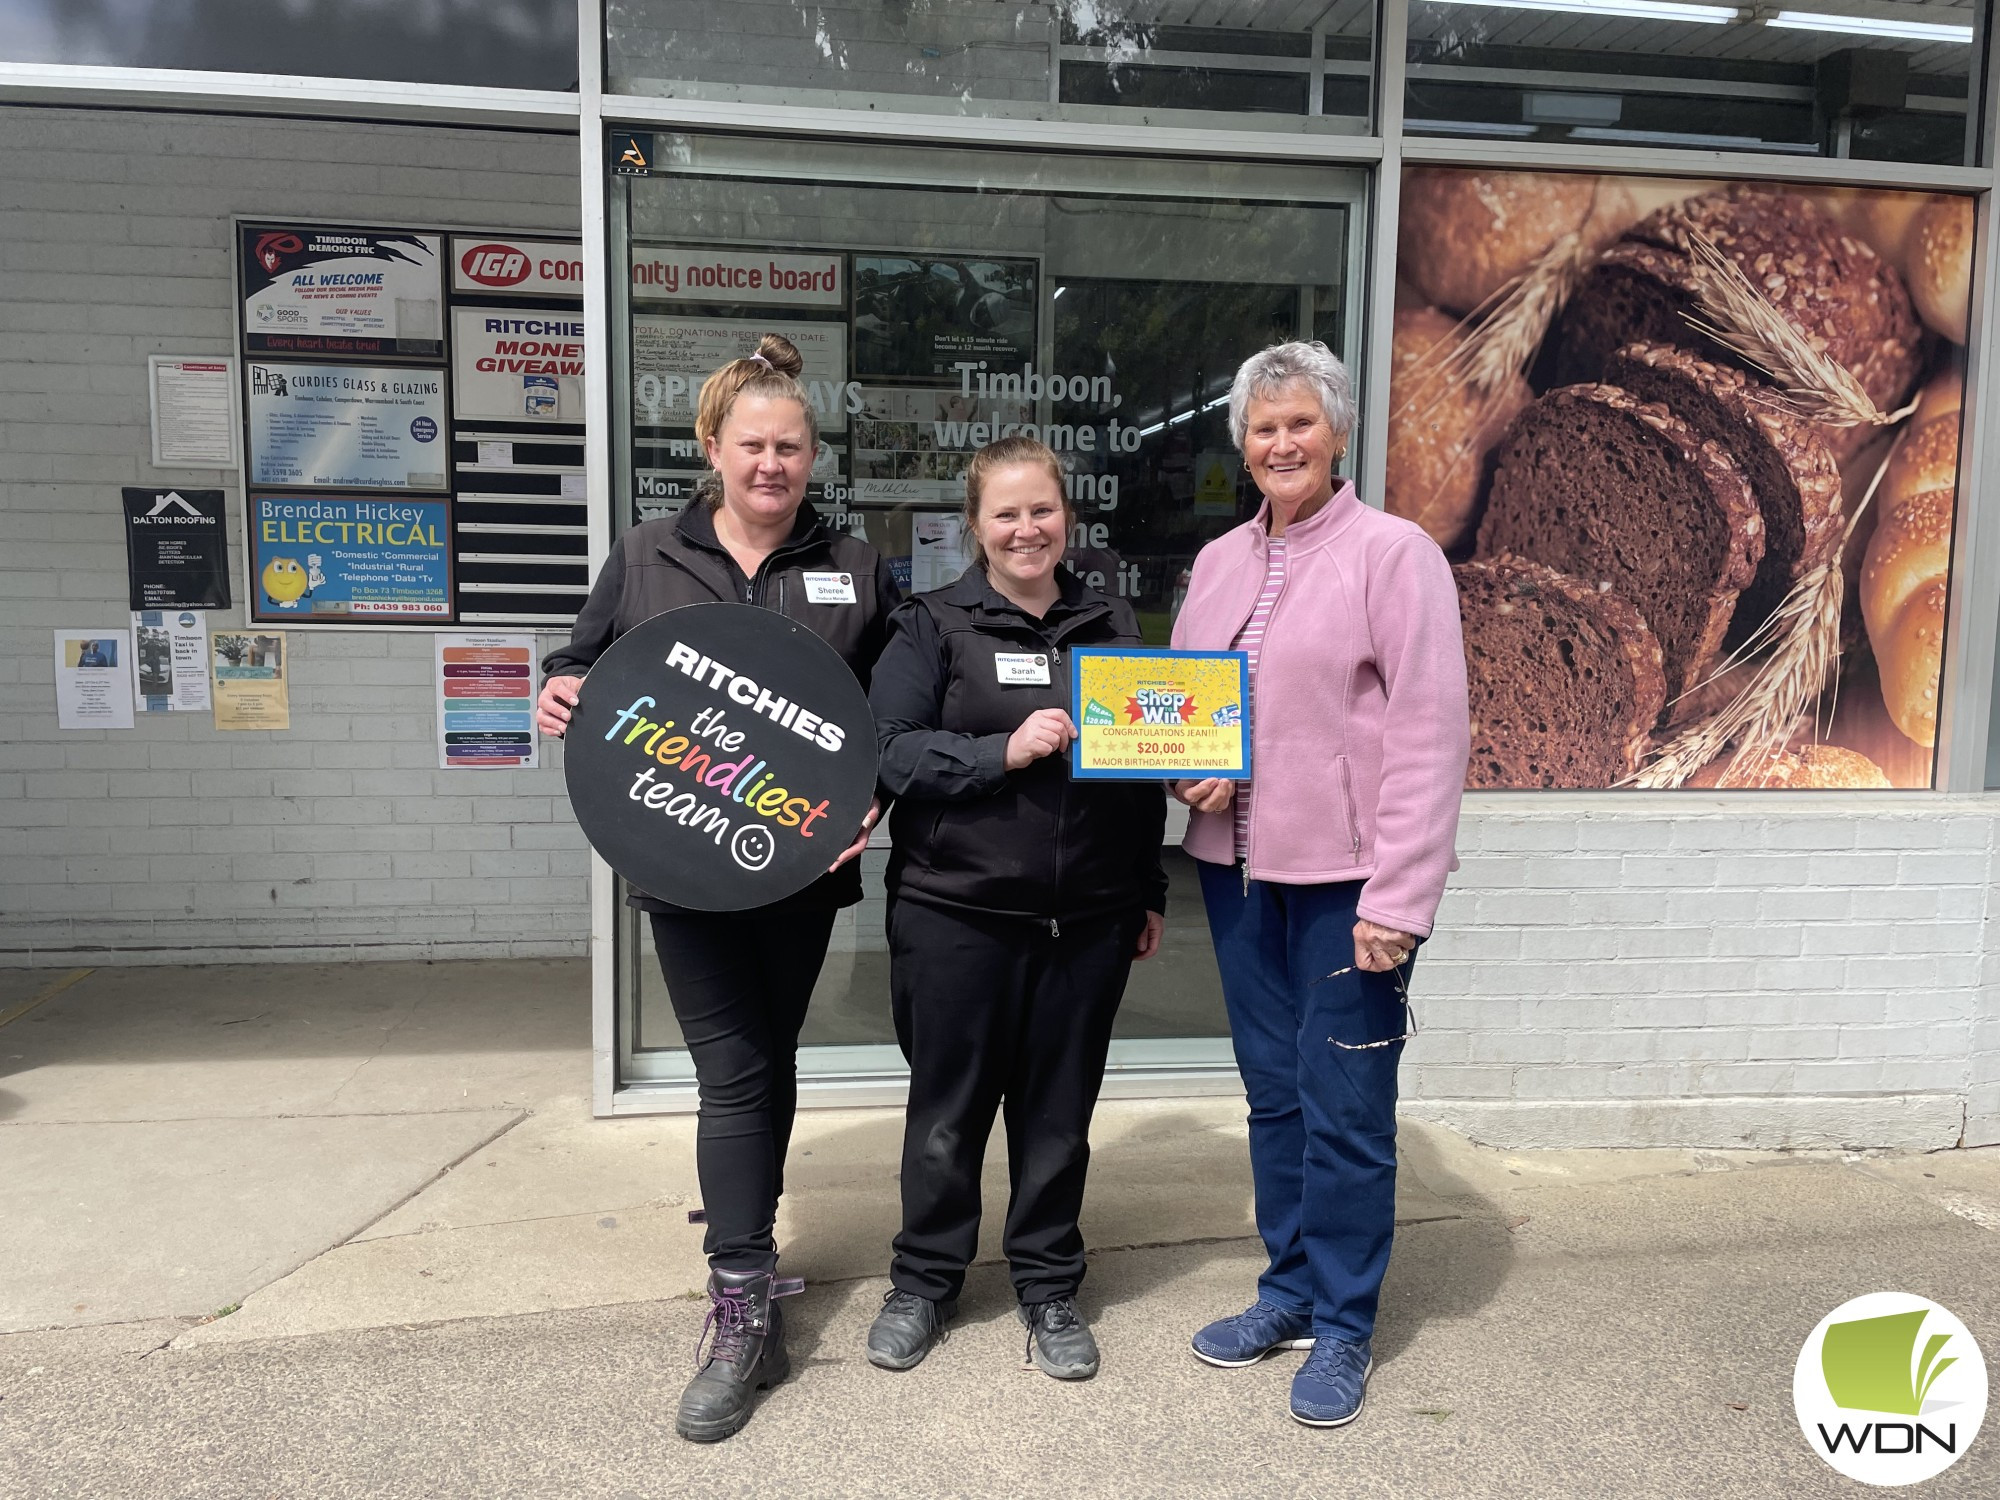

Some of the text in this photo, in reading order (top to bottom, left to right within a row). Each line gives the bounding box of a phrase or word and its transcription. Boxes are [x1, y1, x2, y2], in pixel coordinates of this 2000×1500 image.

[315, 236, 367, 245] TIMBOON
[308, 244, 375, 254] DEMONS FNC
[292, 273, 384, 286] ALL WELCOME
[468, 252, 525, 278] IGA
[686, 264, 762, 289] notice
[769, 262, 836, 292] board
[485, 318, 584, 336] RITCHIE
[634, 326, 665, 335] TOTAL
[669, 328, 728, 338] DONATIONS
[784, 332, 798, 342] TO
[800, 334, 829, 342] DATE:
[266, 336, 294, 349] Every
[296, 336, 324, 349] heart
[326, 338, 354, 350] beats
[292, 376, 438, 395] CURDIES GLASS & GLAZING
[954, 360, 1122, 408] Timboon,
[413, 426, 435, 434] Emergency
[1107, 418, 1142, 453] to
[313, 476, 406, 487] Email: andrew@curdiesglass.com
[133, 516, 216, 524] DALTON ROOFING
[262, 501, 424, 524] Brendan Hickey
[262, 520, 444, 547] ELECTRICAL
[1116, 560, 1142, 597] it
[352, 586, 444, 596] Po Box 73 Timboon 3268
[818, 586, 844, 594] Sheree
[354, 603, 371, 611] Ph:
[665, 640, 846, 752] RITCHIES
[1136, 688, 1186, 712] Shop
[1086, 716, 1113, 726] $20,000
[1141, 706, 1182, 724] Win
[690, 706, 746, 753] the
[1102, 728, 1218, 737] CONGRATULATIONS JEAN!!!
[1137, 742, 1185, 754] $20,000
[604, 695, 830, 838] friendliest
[1092, 758, 1230, 767] MAJOR BIRTHDAY PRIZE WINNER
[628, 767, 732, 846] team
